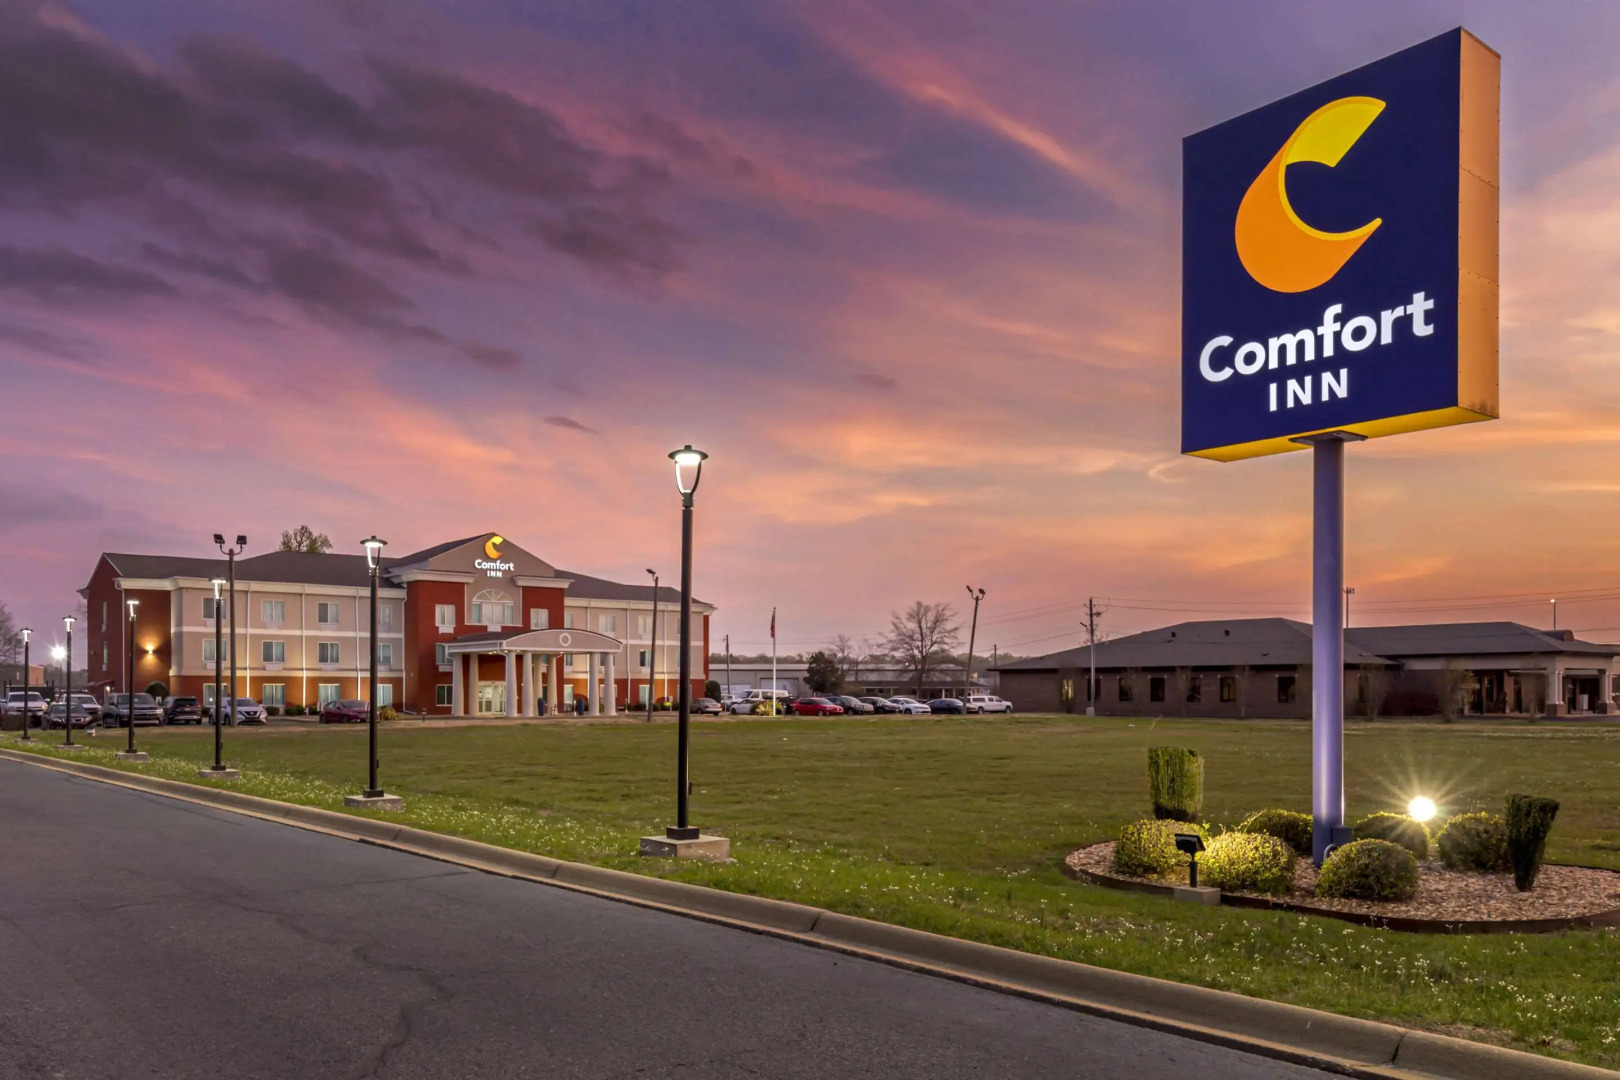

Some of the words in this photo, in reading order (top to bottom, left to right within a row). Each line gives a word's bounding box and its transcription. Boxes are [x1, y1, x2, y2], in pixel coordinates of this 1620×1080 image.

[1199, 291, 1434, 382] Comfort
[1269, 368, 1348, 412] INN
[474, 559, 514, 571] Comfort
